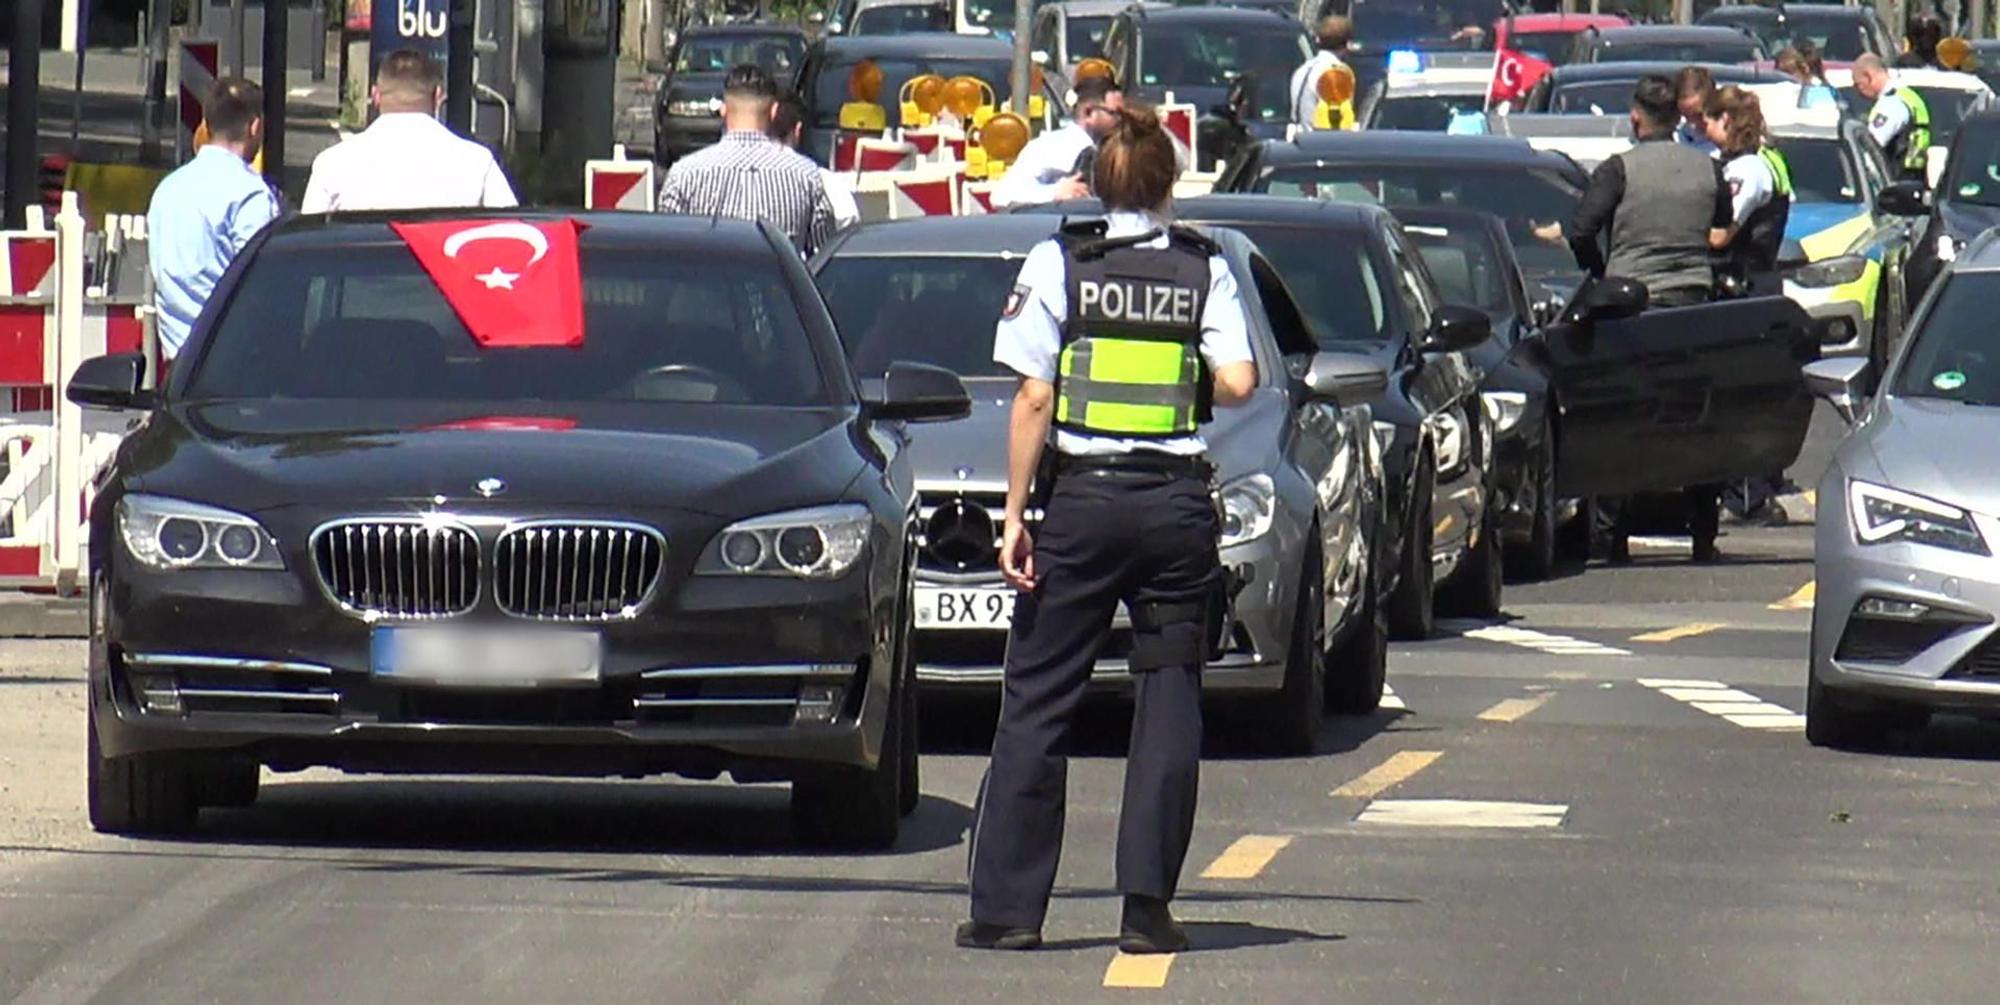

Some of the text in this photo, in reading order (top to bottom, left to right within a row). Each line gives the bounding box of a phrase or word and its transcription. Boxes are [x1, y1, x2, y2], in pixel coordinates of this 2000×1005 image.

[398, 0, 447, 37] blu
[1080, 281, 1199, 322] POLIZEI
[937, 593, 976, 622] BX
